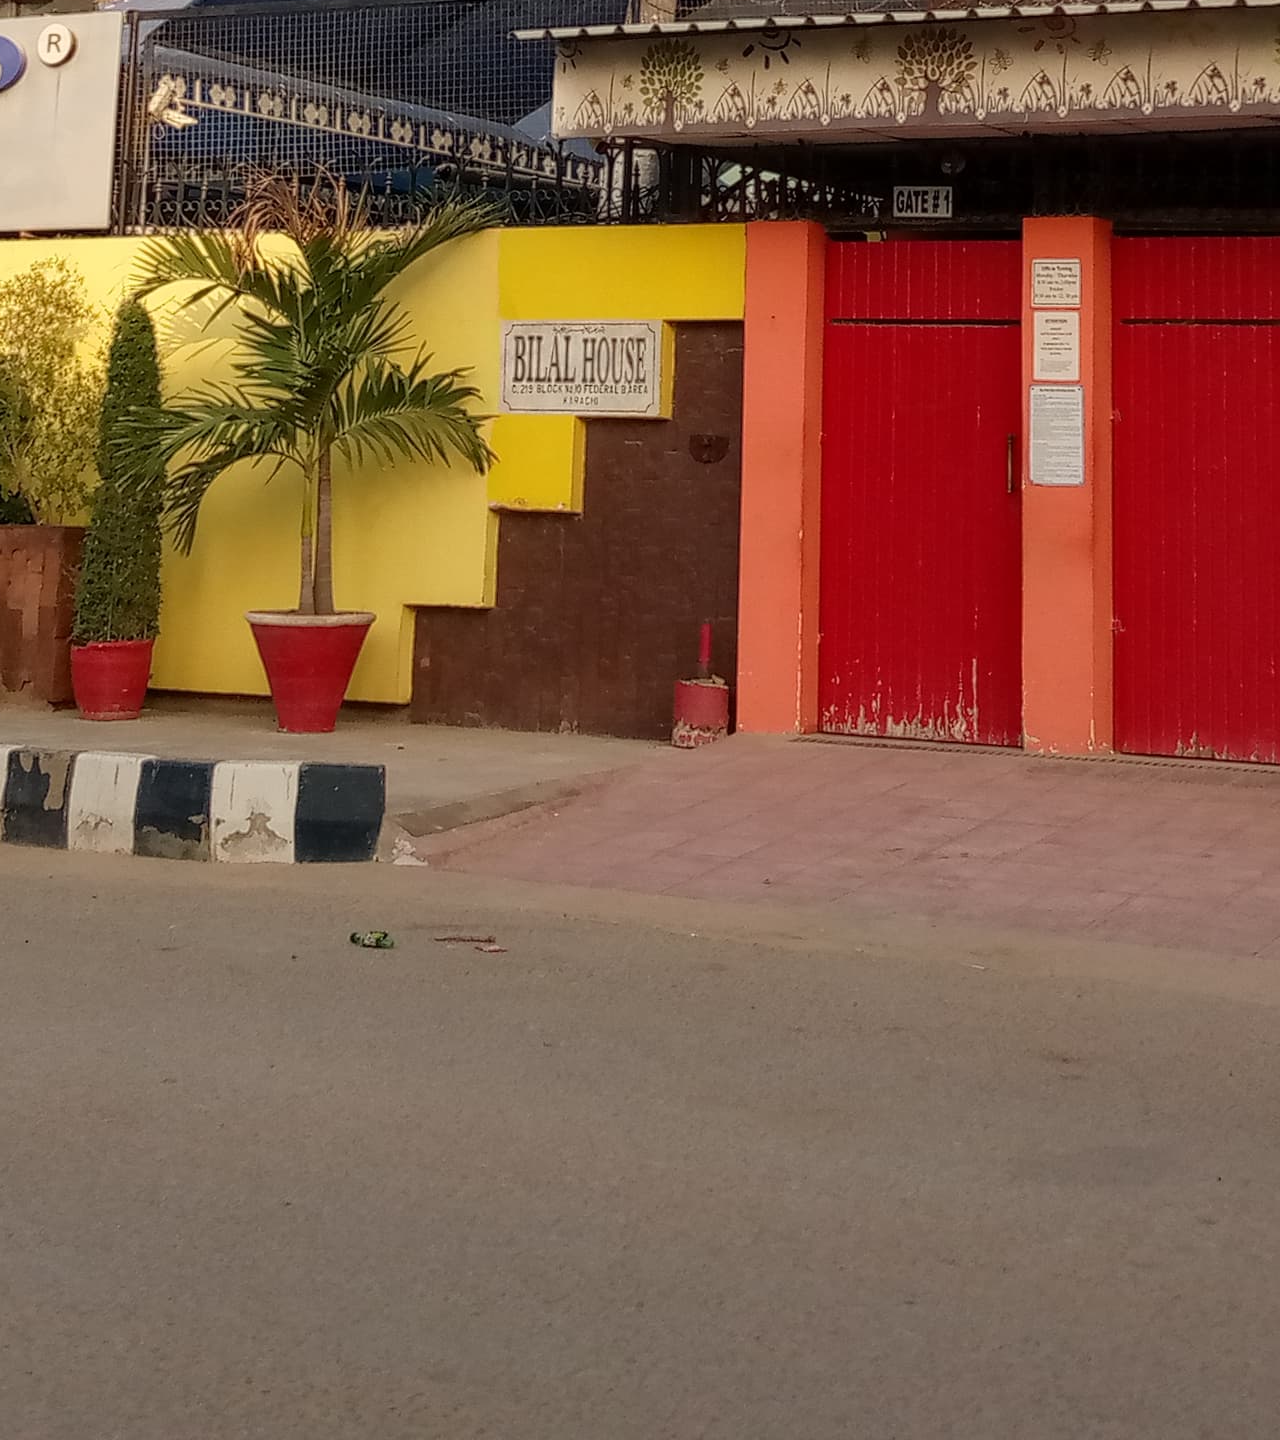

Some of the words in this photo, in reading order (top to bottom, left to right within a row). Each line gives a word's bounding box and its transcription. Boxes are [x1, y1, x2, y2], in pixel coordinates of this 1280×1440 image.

[896, 189, 929, 213] GATE
[932, 189, 940, 214] #
[944, 189, 950, 215] 1
[512, 333, 576, 383] BILAL
[581, 336, 647, 385] HOUSE
[536, 384, 563, 394] BLOCK
[583, 383, 619, 394] FEDERAL
